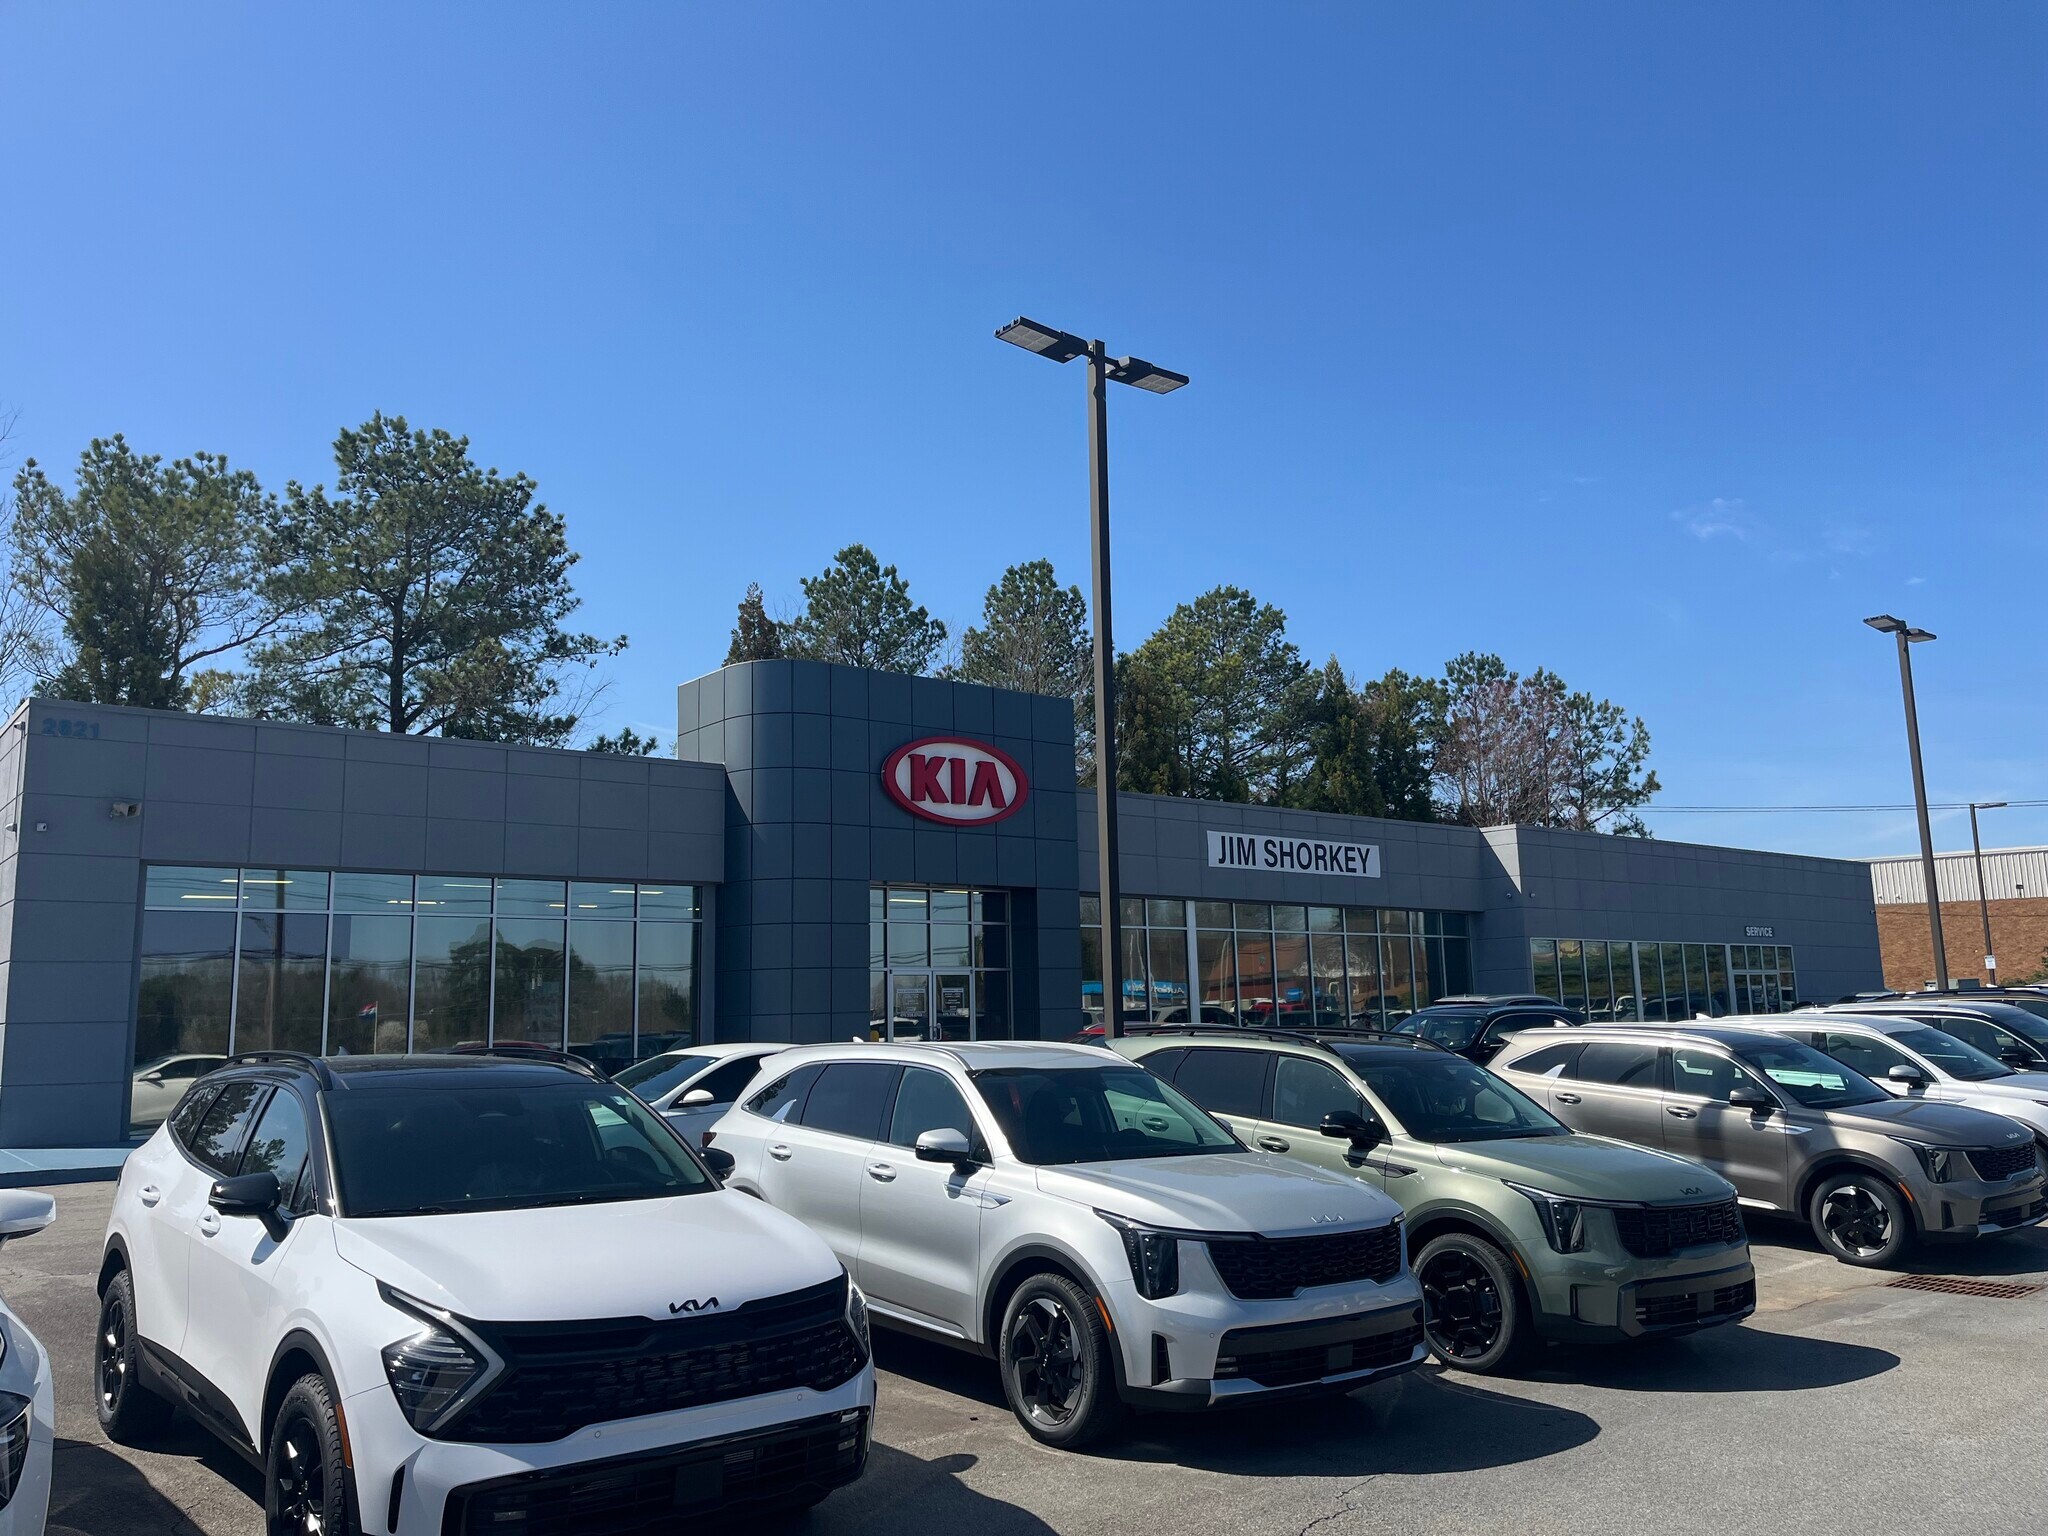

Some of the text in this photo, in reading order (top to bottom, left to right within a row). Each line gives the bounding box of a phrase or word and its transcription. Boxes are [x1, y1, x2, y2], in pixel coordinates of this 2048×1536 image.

[908, 753, 1007, 809] KIA
[1218, 835, 1371, 874] JIM SHORKEY
[1745, 926, 1773, 937] SERVICE
[669, 1296, 719, 1314] KIA
